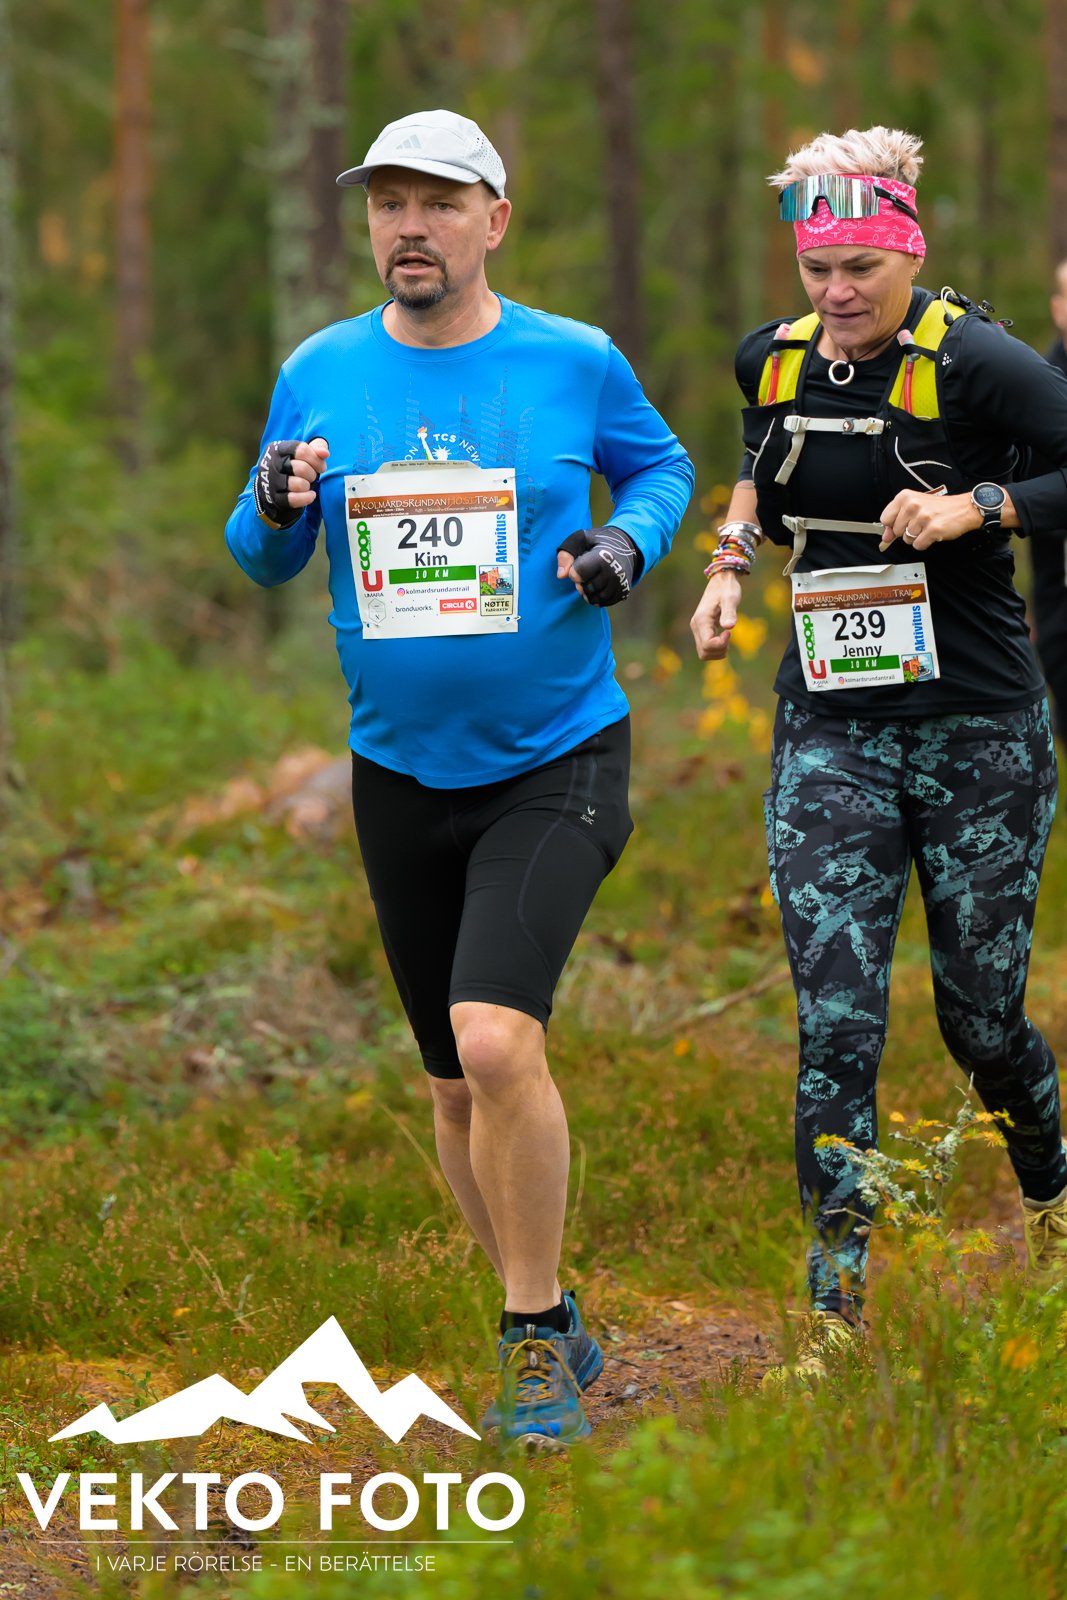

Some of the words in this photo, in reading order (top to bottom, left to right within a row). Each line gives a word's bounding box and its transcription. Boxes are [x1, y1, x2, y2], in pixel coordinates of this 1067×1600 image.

[432, 433, 457, 443] TCS
[459, 439, 480, 462] NEW
[260, 446, 273, 504] CRAFT
[356, 521, 371, 571] coop
[397, 516, 464, 550] 240
[495, 513, 508, 563] Aktivitus
[415, 552, 448, 567] Kim
[415, 569, 428, 580] 10
[434, 569, 450, 579] KM
[598, 549, 631, 592] CRAFT
[802, 614, 816, 660] coop
[832, 609, 886, 641] 239
[912, 605, 926, 651] Aktivitus
[842, 644, 882, 659] Jenny
[850, 660, 860, 669] 10
[865, 659, 877, 668] KM
